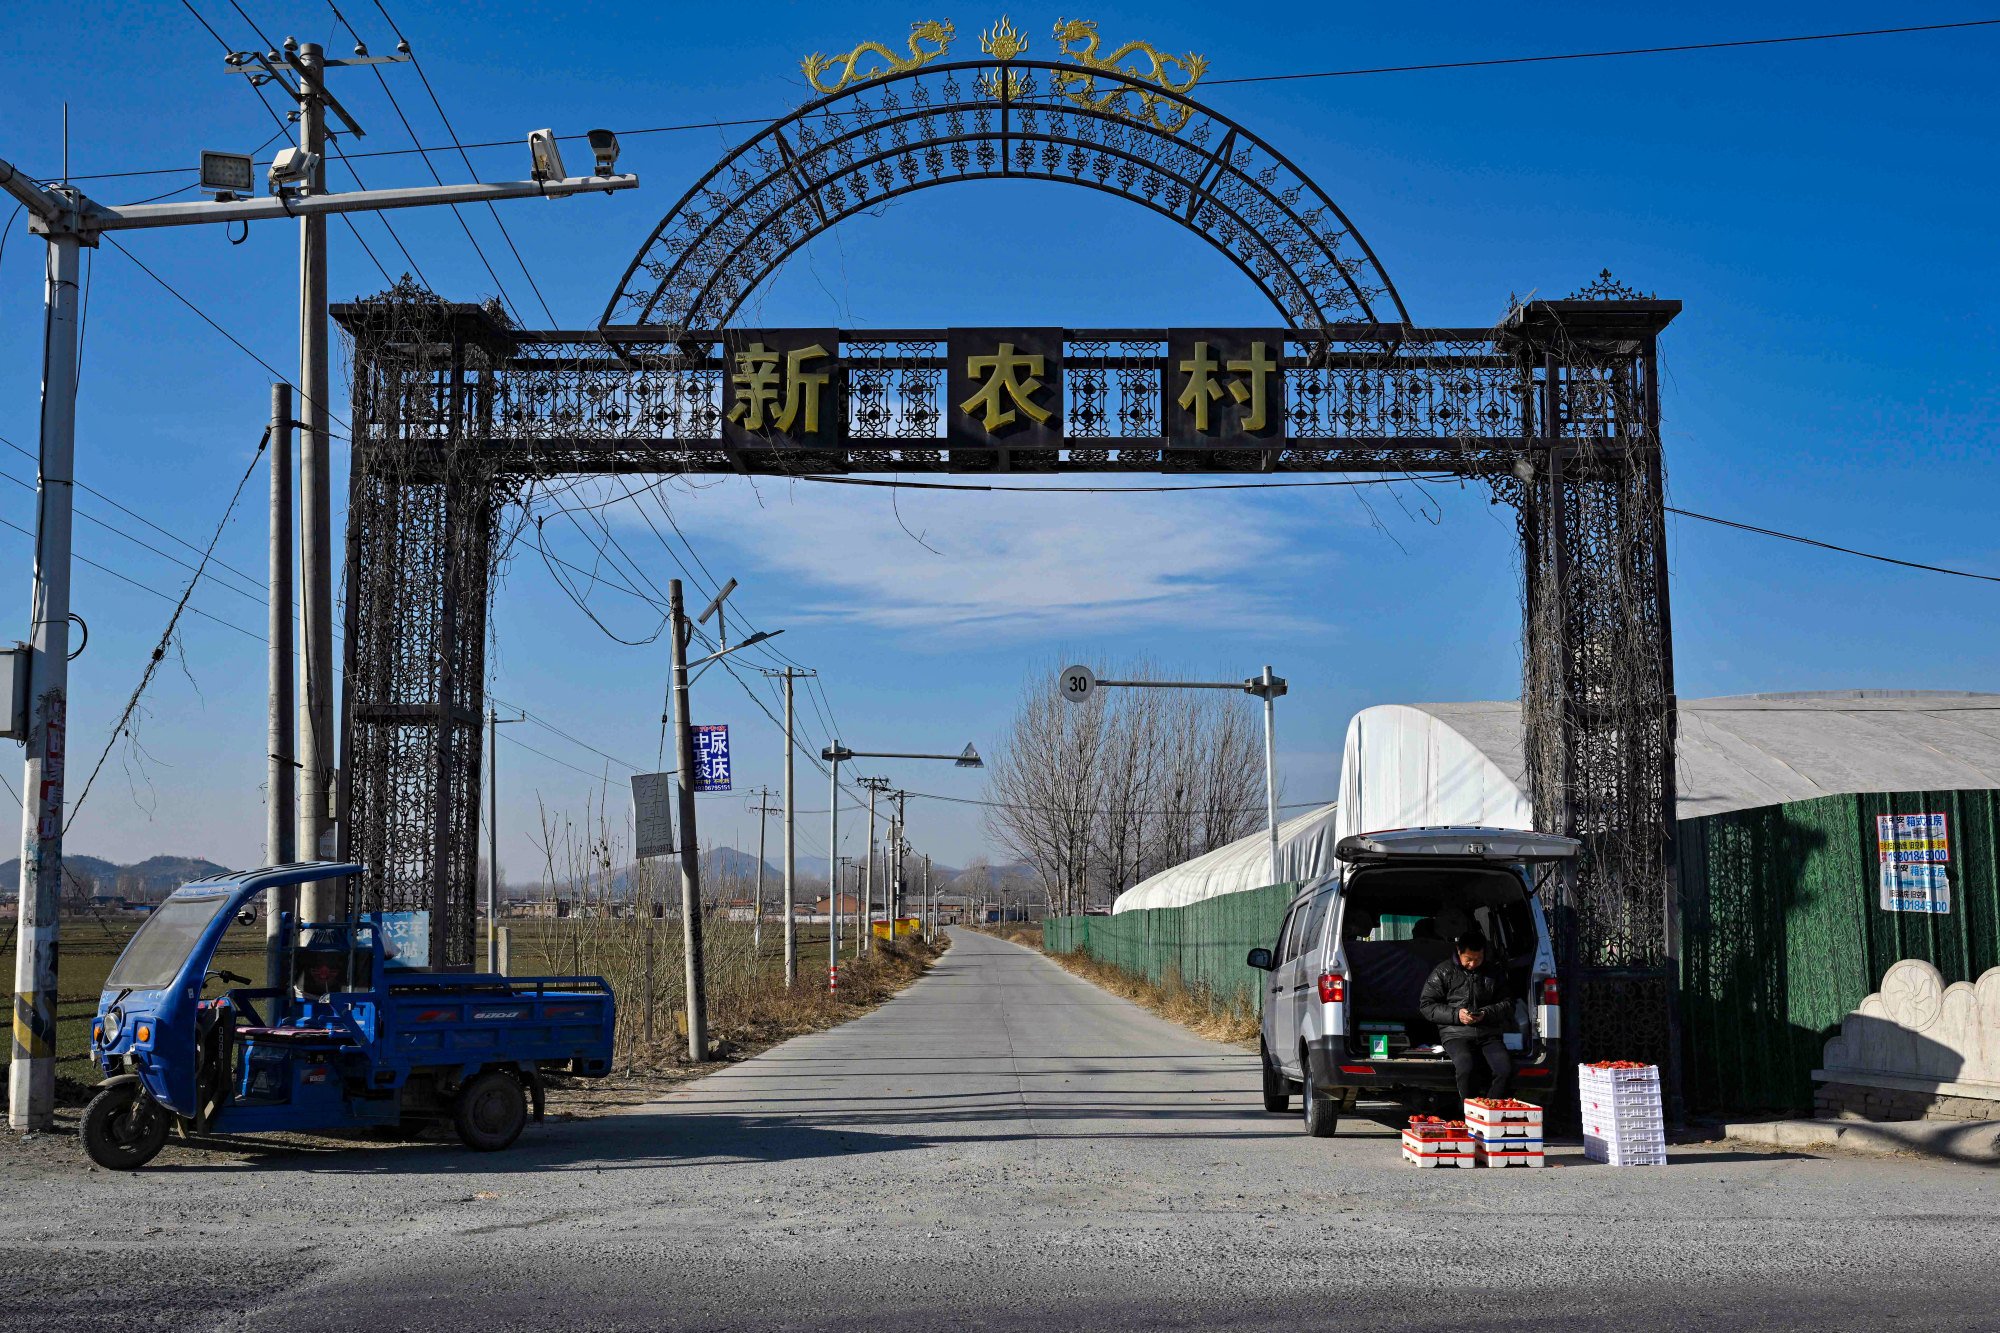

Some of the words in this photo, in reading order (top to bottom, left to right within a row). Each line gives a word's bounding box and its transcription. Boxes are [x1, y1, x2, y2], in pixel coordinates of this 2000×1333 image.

[726, 341, 1277, 434] 新农村
[1069, 676, 1087, 692] 30
[693, 733, 711, 779] 中耳炎
[710, 731, 729, 779] 尿床
[1888, 849, 1946, 862] 19801845000
